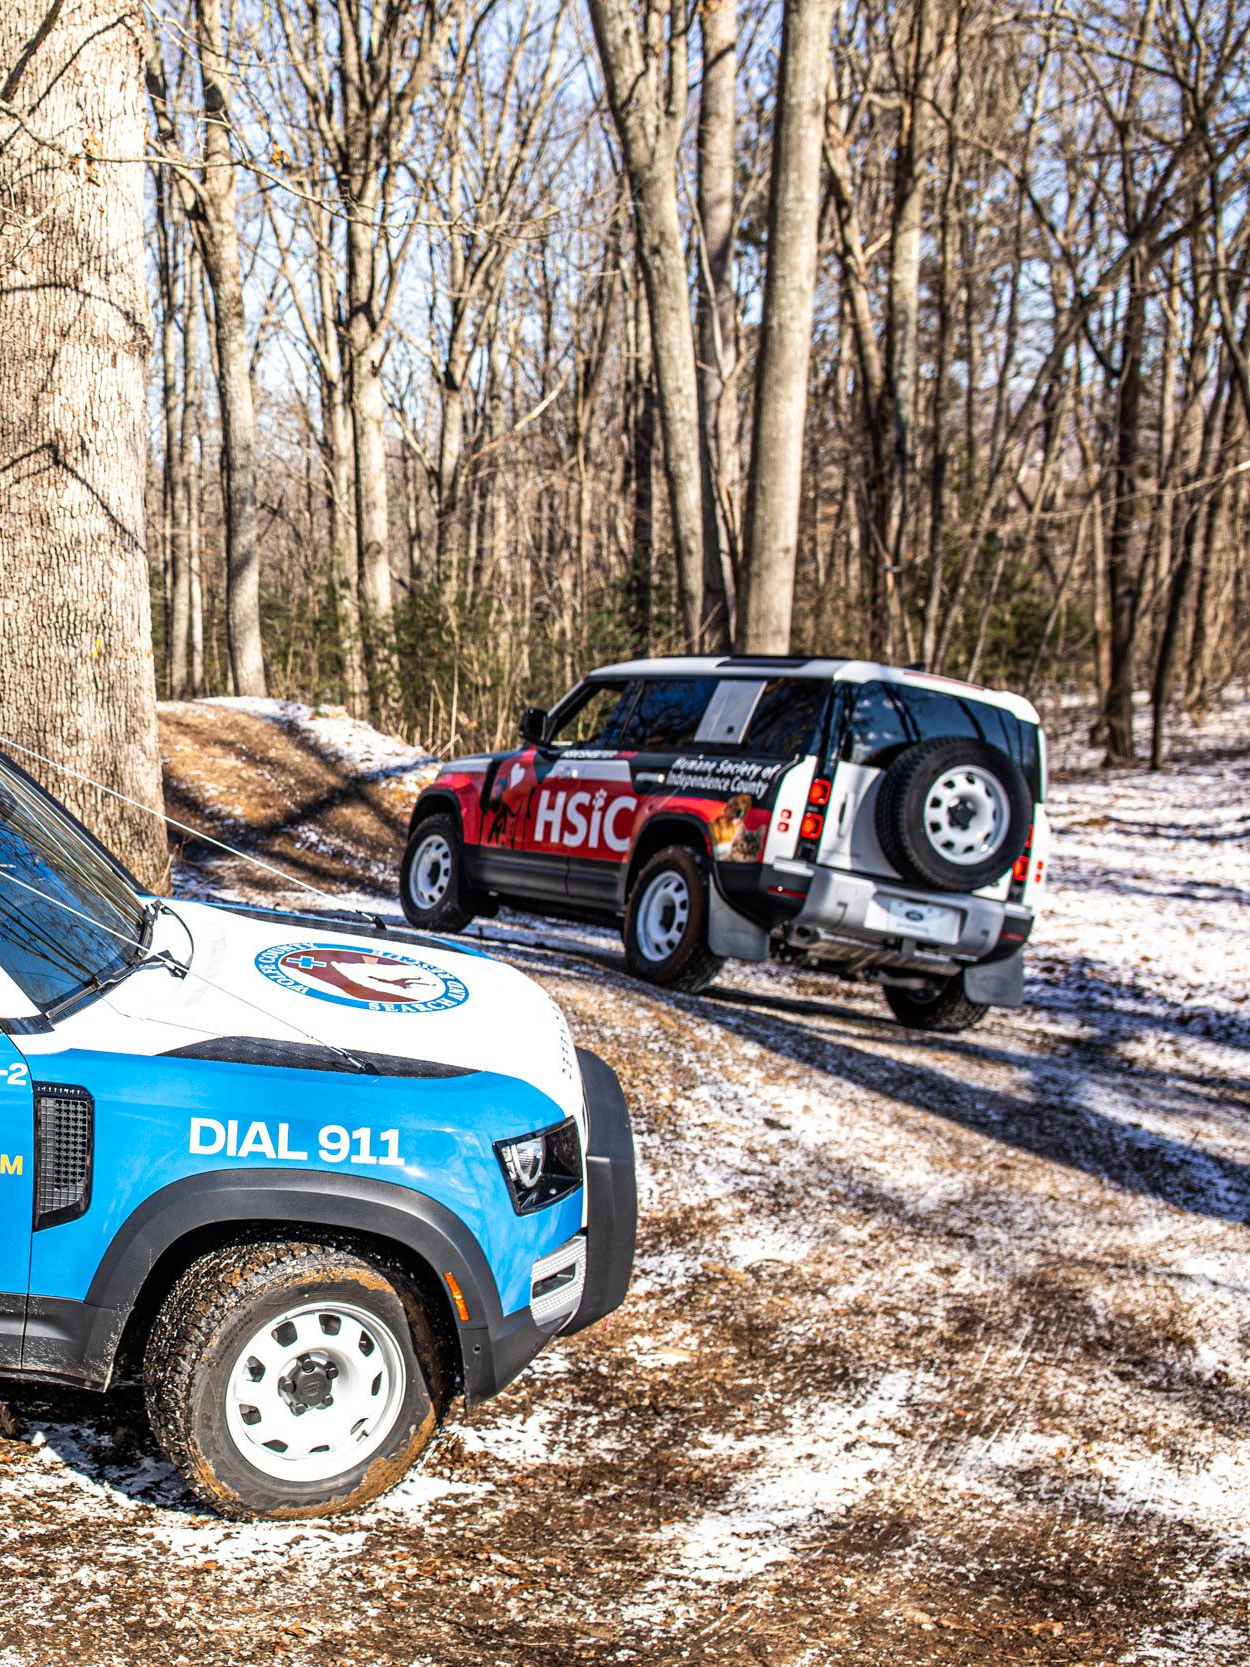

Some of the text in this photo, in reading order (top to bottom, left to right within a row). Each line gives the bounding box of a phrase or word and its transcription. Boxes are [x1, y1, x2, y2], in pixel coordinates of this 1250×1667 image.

[671, 757, 781, 780] Humane Society of
[666, 770, 769, 800] Independence County
[259, 963, 310, 995] WOLFE
[368, 998, 454, 1013] SEARCH
[446, 981, 468, 1001] AND
[189, 1117, 405, 1166] DIAL 911
